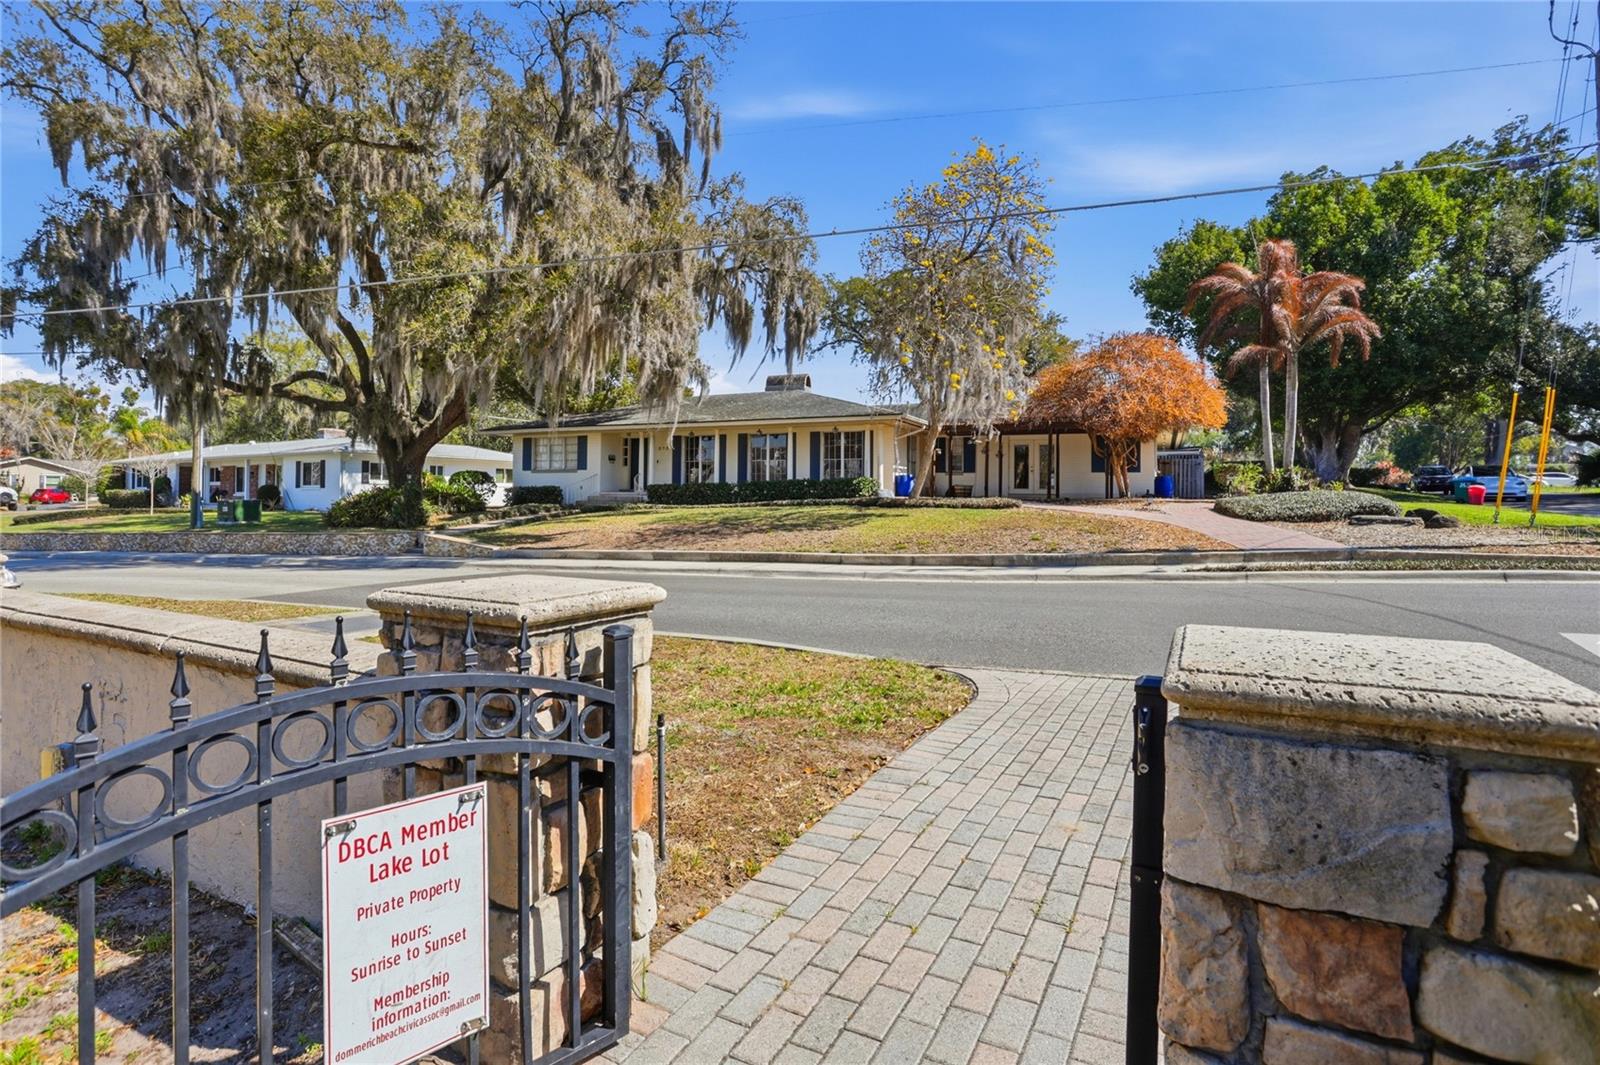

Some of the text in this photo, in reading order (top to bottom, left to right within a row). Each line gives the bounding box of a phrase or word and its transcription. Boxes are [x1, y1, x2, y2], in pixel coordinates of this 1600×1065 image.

[338, 810, 477, 863] DBCA Member
[369, 842, 449, 883] Lake Lot
[357, 878, 461, 921] Private Property
[351, 928, 467, 982] Sunrise to Sunset
[391, 924, 432, 948] Hours:
[371, 990, 451, 1032] information:
[374, 971, 450, 1011] Membership
[335, 993, 481, 1063] dommerichbeachcivicassoc@gmail.com
